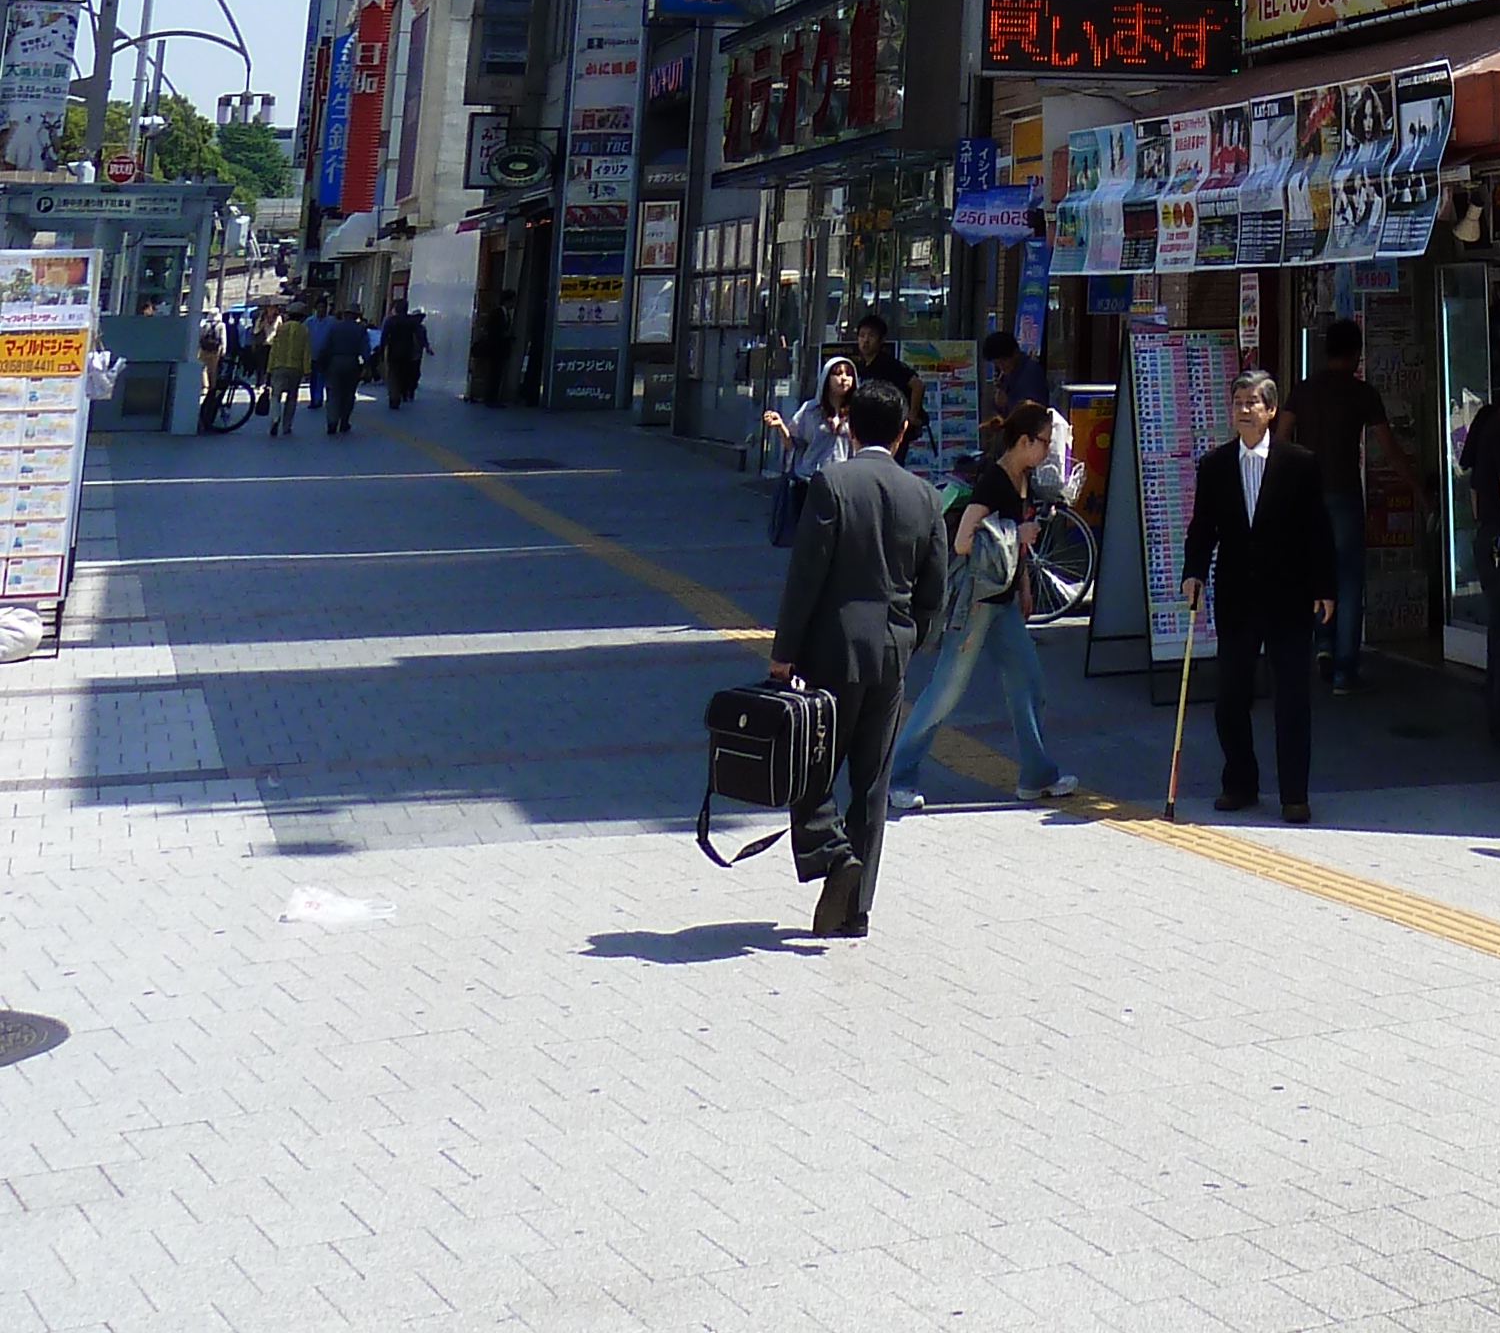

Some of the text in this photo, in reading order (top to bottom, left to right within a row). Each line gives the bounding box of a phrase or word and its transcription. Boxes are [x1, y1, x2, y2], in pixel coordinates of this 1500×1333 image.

[324, 61, 351, 184] 新生銀行
[5, 339, 83, 357] マイルドシティ
[556, 360, 615, 373] ナガフジビル
